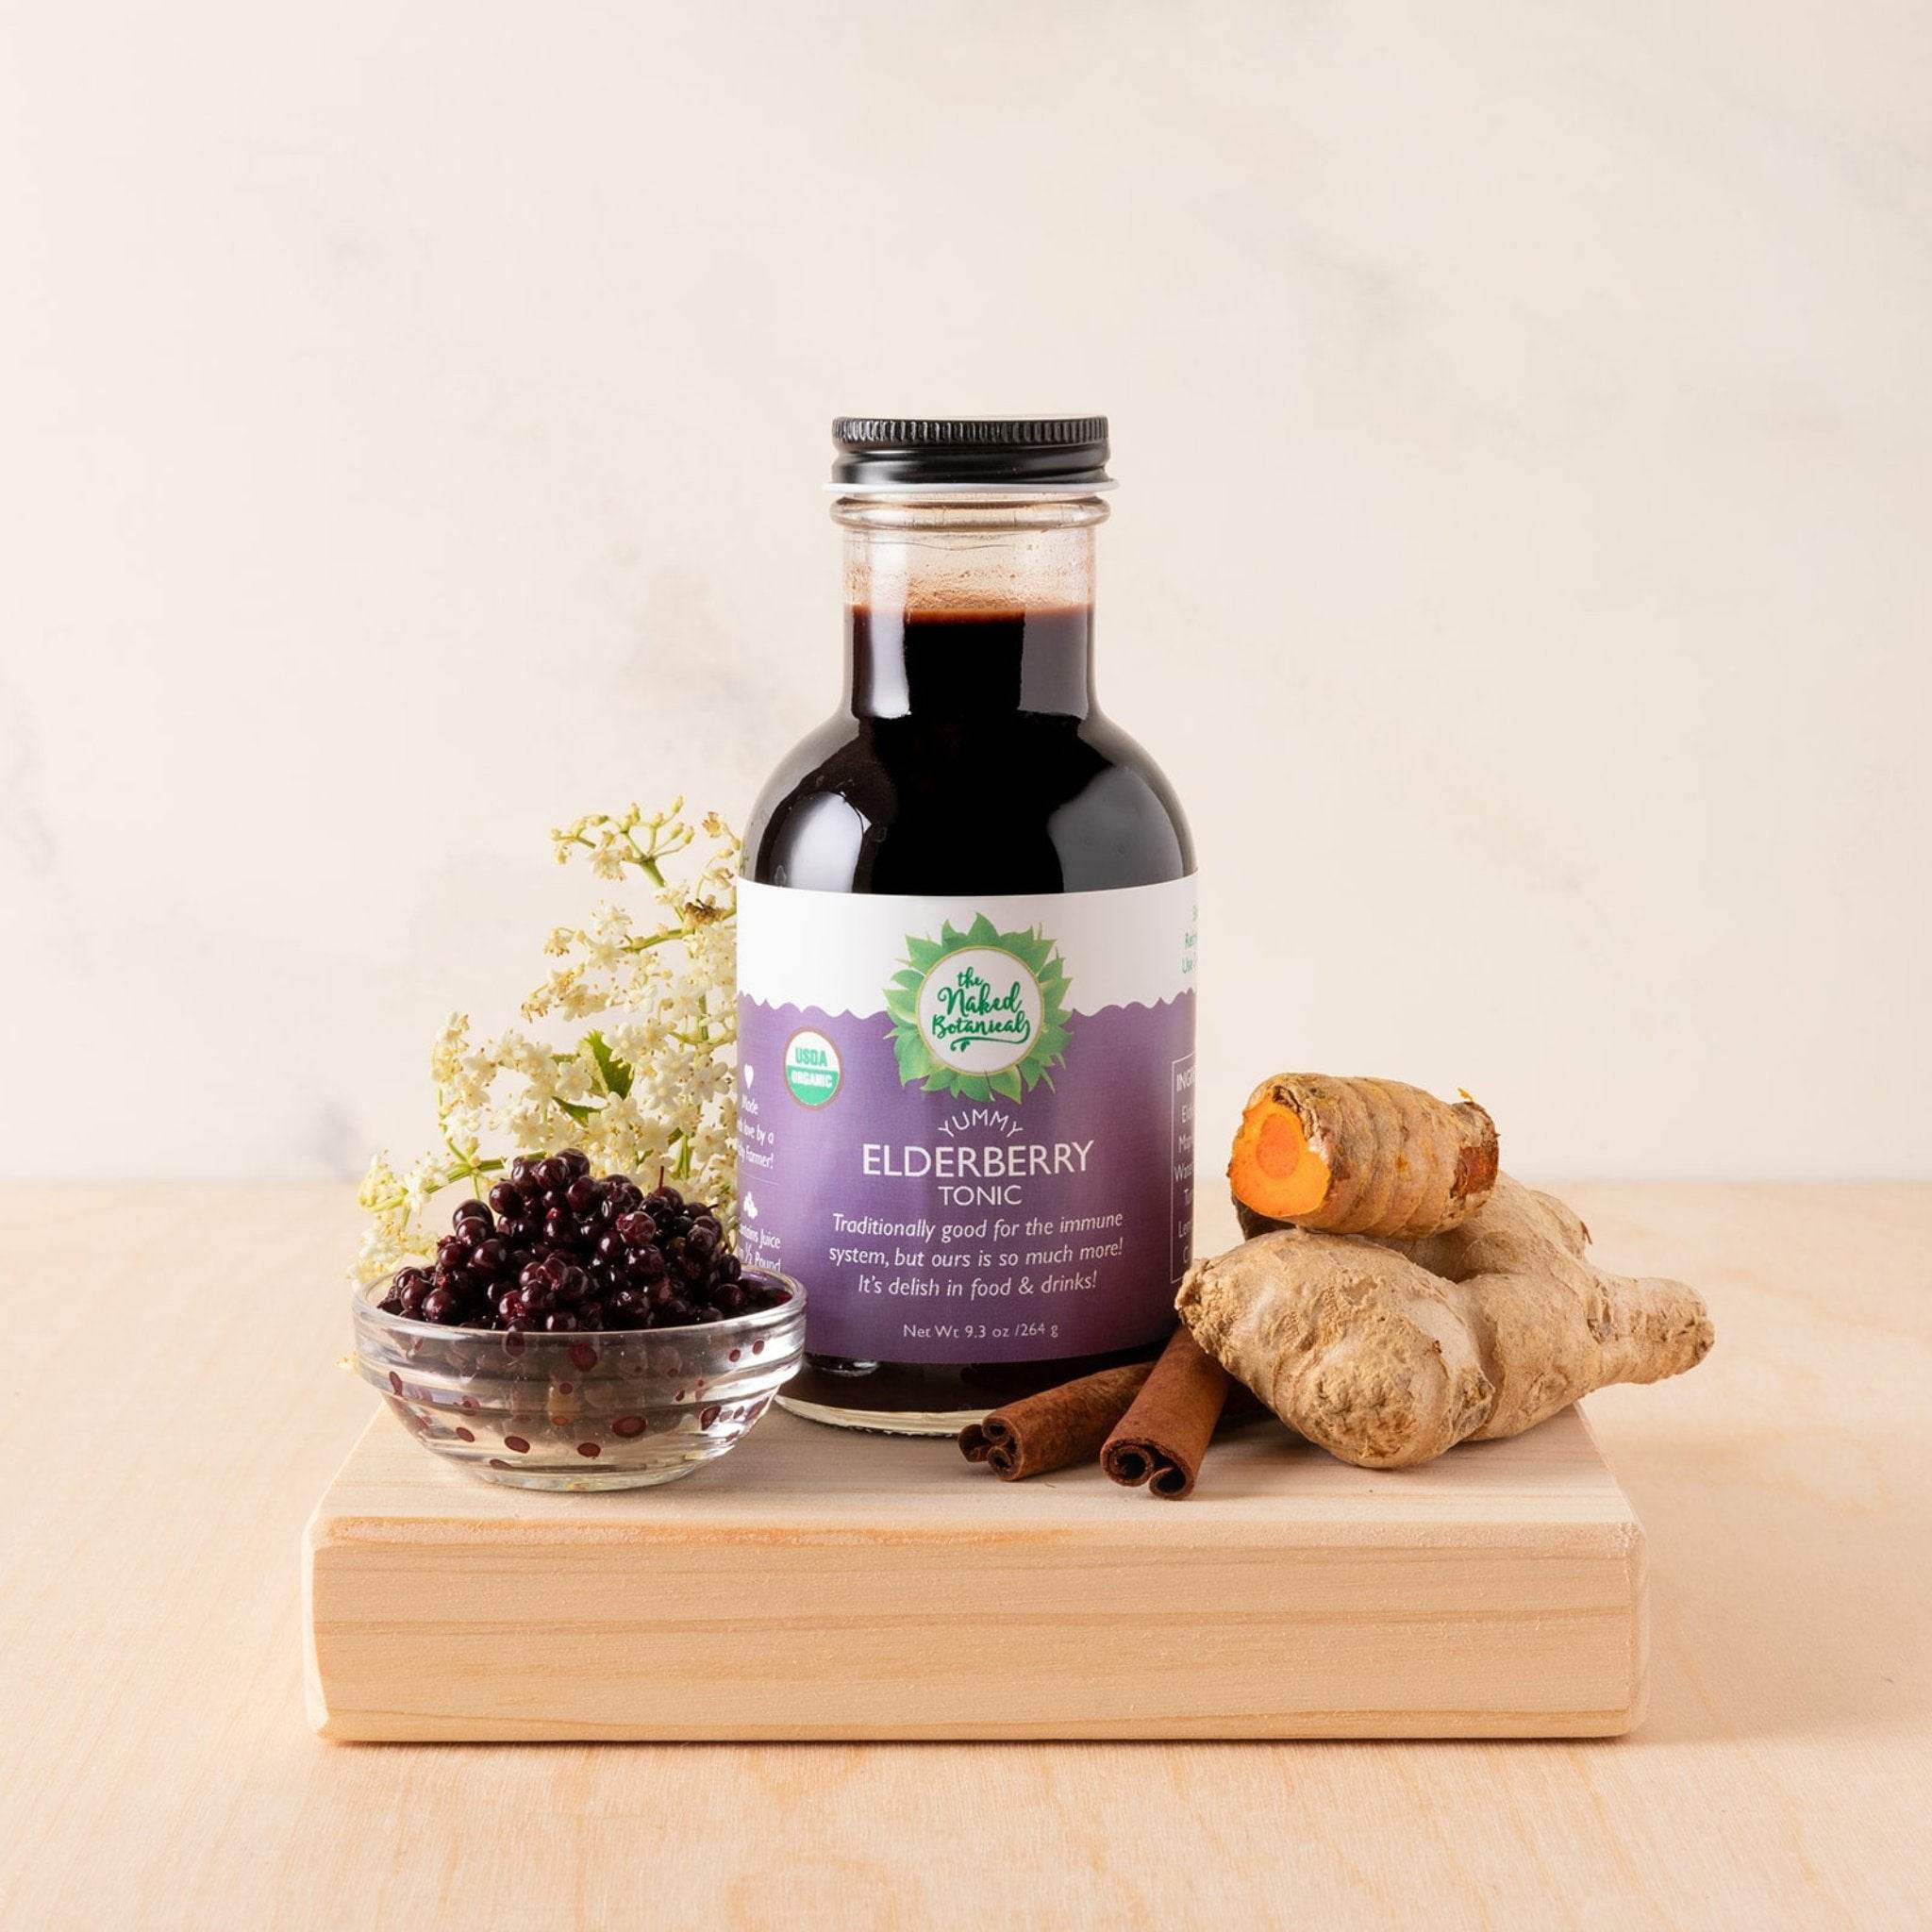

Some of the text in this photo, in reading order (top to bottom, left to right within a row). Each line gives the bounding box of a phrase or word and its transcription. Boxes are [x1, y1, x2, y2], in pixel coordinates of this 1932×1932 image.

[958, 966, 983, 989] the
[938, 981, 1023, 1017] Naked
[795, 1046, 828, 1067] USDA
[938, 1108, 1024, 1138] YUMMY
[862, 1140, 1094, 1177] ELDERBERRY
[938, 1185, 1023, 1206] TONIC
[832, 1212, 1123, 1243] Traditionally good for the immune
[829, 1237, 1124, 1267] system, but ours is so much more!
[858, 1270, 1097, 1301] It’s delish in food & drinks!
[904, 1324, 931, 1338] Net
[935, 1325, 959, 1339] Wt
[965, 1325, 986, 1339] 9.3
[992, 1328, 1009, 1338] oz
[1050, 1325, 1058, 1338] g
